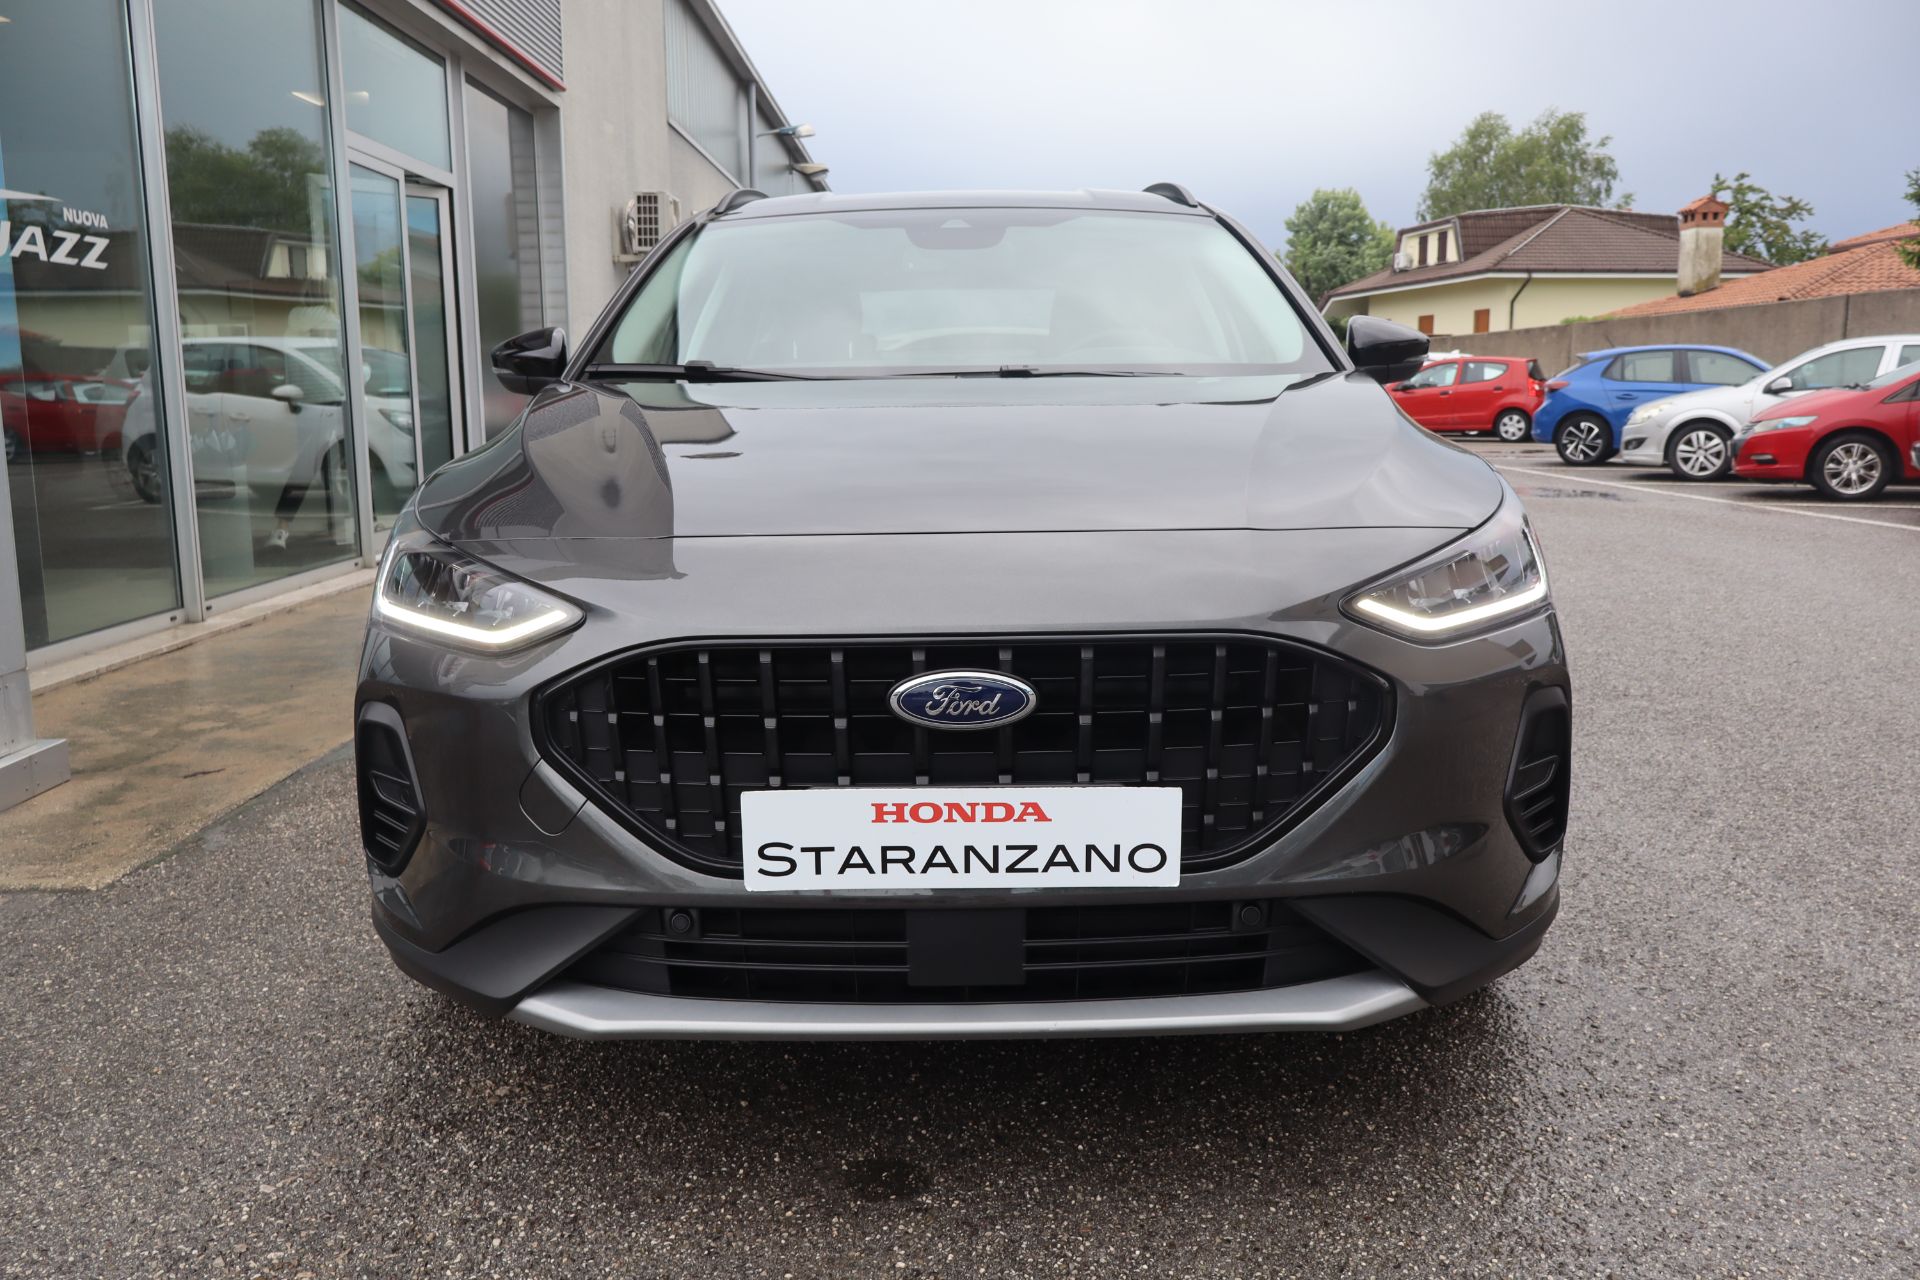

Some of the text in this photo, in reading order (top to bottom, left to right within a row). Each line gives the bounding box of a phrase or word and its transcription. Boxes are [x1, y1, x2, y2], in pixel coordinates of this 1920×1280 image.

[63, 207, 108, 229] NUOVA
[925, 685, 1002, 716] Ford
[871, 802, 1052, 823] HONDA
[757, 842, 1168, 877] STARANZANO
